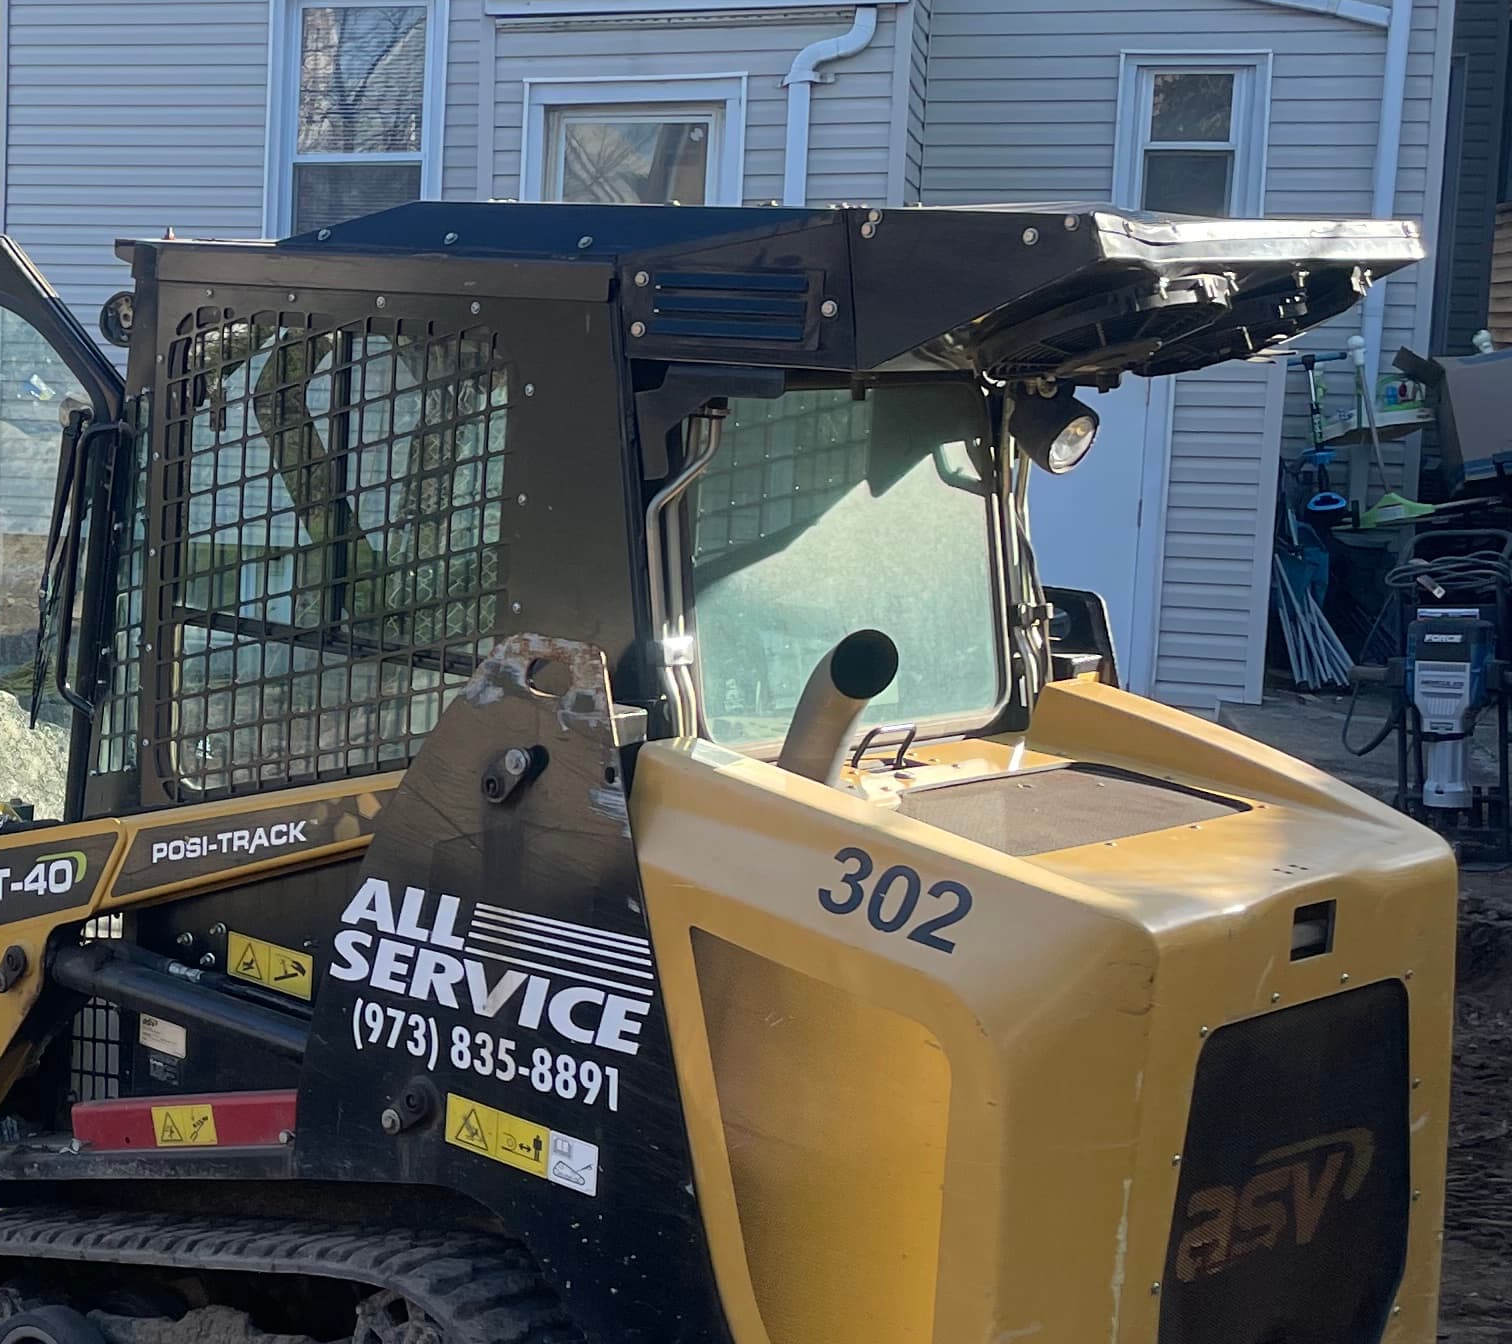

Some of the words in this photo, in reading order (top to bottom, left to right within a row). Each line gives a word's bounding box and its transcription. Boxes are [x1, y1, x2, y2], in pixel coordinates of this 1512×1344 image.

[151, 820, 308, 864] POSI-TRACK
[340, 877, 465, 952] ALL
[817, 846, 974, 954] 302
[329, 929, 651, 1056] SERVICE
[352, 997, 439, 1071] (973)
[449, 1026, 619, 1112] 835-8891
